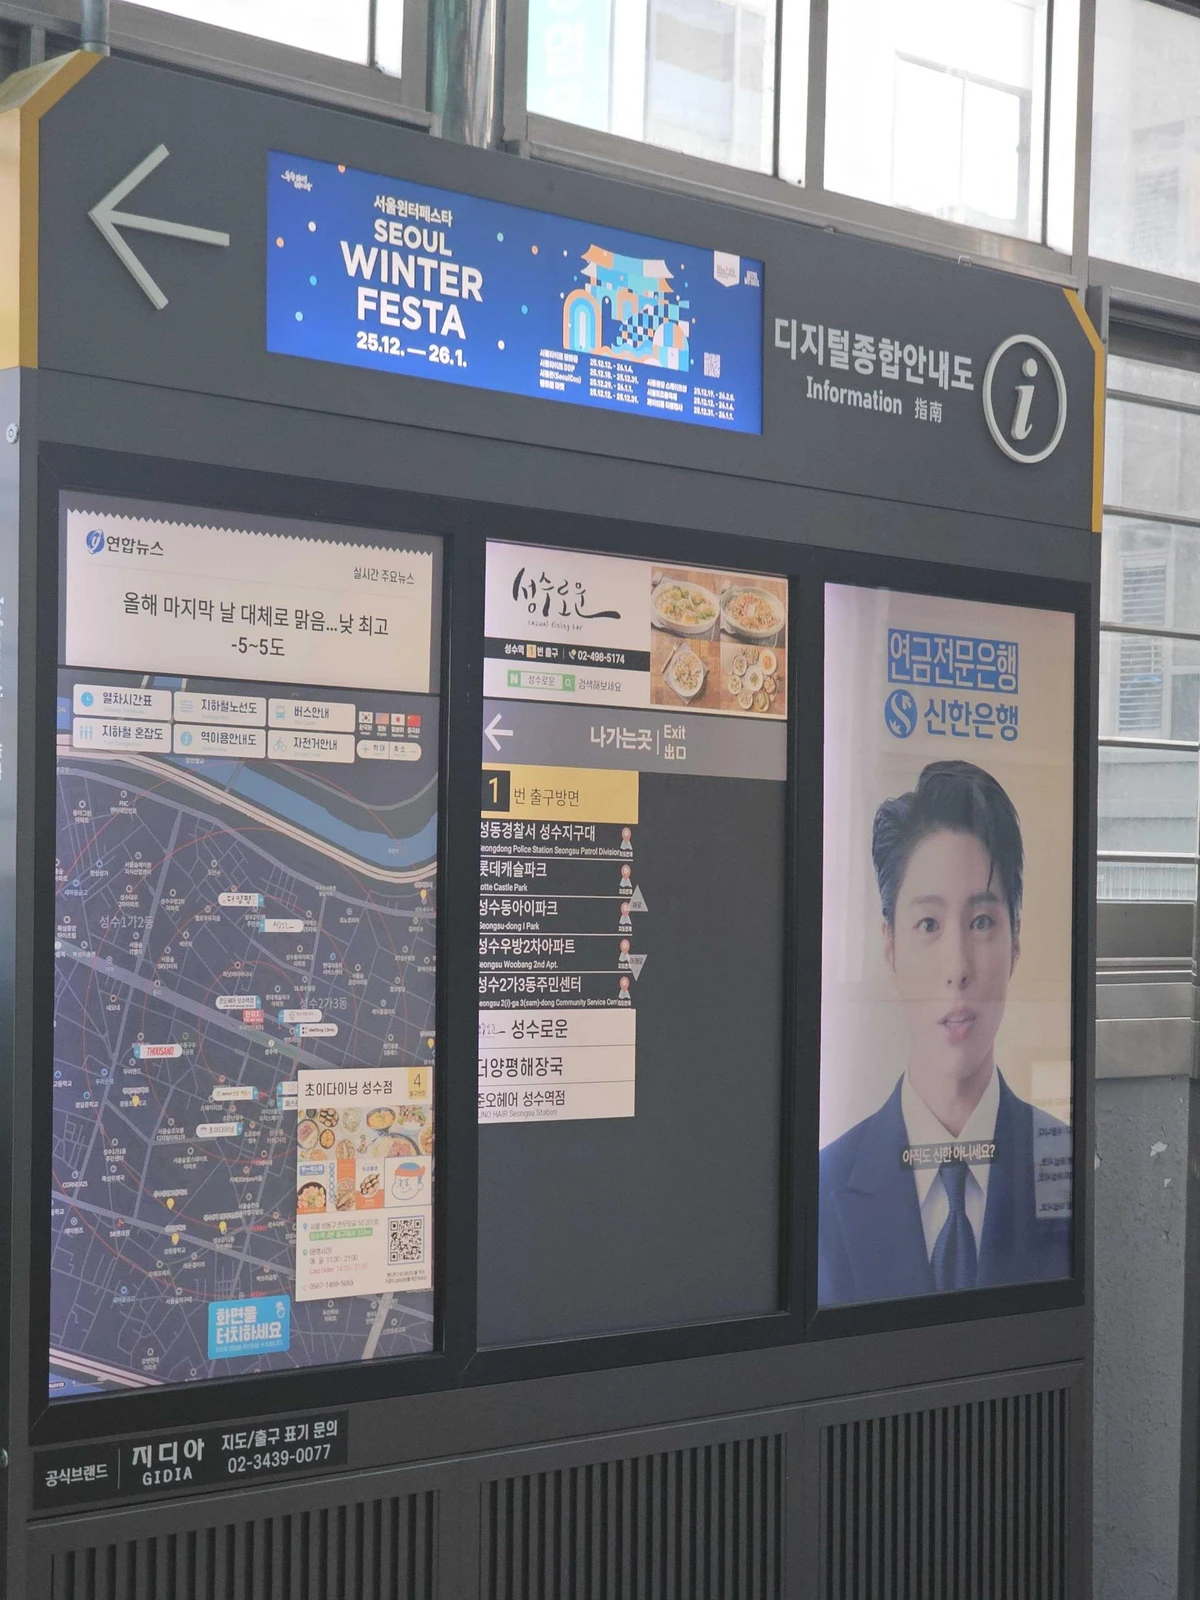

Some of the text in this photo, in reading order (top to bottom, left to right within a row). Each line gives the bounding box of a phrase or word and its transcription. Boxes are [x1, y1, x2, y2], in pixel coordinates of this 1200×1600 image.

[374, 195, 453, 228] 서울윈터페스타
[374, 218, 453, 257] SEOUL
[340, 240, 484, 303] WINTER
[357, 286, 467, 340] FESTA
[356, 331, 405, 356] 25.12.
[428, 344, 468, 368] 26.1.
[774, 317, 975, 391] 디지털종합안내도
[806, 375, 903, 416] Information
[914, 397, 943, 423] 指南
[106, 535, 164, 556] 연합뉴스
[353, 566, 415, 585] 실시간 주요뉴스
[124, 591, 157, 616] 올해
[164, 596, 214, 621] 마지막
[220, 601, 236, 623] 날
[241, 603, 289, 628] 대체로
[358, 615, 389, 637] 최고
[231, 636, 285, 656] -5~5도
[504, 643, 525, 655] 성수역
[577, 650, 625, 664] 02-498-5174
[890, 632, 1016, 691] 연금전문은행
[528, 675, 556, 687] 성수로운
[578, 679, 622, 692] 검색해보세요
[102, 691, 152, 707] 열차시간표
[201, 699, 257, 714] 지하철노선도
[294, 706, 330, 719] 버스안내
[924, 698, 1019, 741] 신한은행
[102, 724, 163, 740] 지하철 혼잡도
[201, 731, 256, 746] 역이용안내도
[590, 726, 653, 751] 나가는곳
[663, 724, 686, 740] Exit
[293, 736, 337, 751] 자전거안내
[664, 744, 687, 760] 出口
[488, 777, 580, 807] 1 번 출구방면
[480, 821, 596, 842] 성동경찰서 성수지구대
[481, 844, 512, 855] eongdong
[513, 844, 532, 854] Police
[532, 845, 553, 854] Station
[554, 845, 580, 856] Seongsu
[580, 846, 598, 855] Patrol
[480, 860, 547, 878] 롯데캐슬파크
[493, 883, 528, 892] Castle Park
[480, 899, 558, 917] 성수동아이파크
[100, 915, 155, 930] 성수1가2동
[526, 922, 540, 930] Park
[479, 938, 575, 955] 성수우방2차아파트
[479, 960, 558, 970] eongsu Woobang 2nd Apt.
[479, 976, 581, 994] 성수2가3동주민센터
[300, 998, 347, 1010] 성수2가3동
[556, 998, 586, 1008] Community
[587, 998, 606, 1006] Service
[511, 1019, 568, 1039] 성수로운
[147, 1047, 174, 1056] THOUSAND
[305, 1080, 393, 1097] 초이다이닝 성수점
[413, 1073, 422, 1088] 4
[522, 1090, 565, 1107] 성수역점
[493, 1110, 508, 1118] HAIR
[509, 1109, 535, 1118] Seongsu
[536, 1108, 557, 1116] Station
[902, 1143, 996, 1166] 아직도 신한 아니세요?
[216, 1306, 257, 1326] 화면을
[216, 1321, 282, 1345] 터치하세요
[221, 1419, 338, 1451] 지도/출구 표기 문의
[227, 1444, 331, 1474] 02-3439-0077
[45, 1463, 108, 1487] 공식브랜드
[142, 1466, 193, 1486] GIDIA
